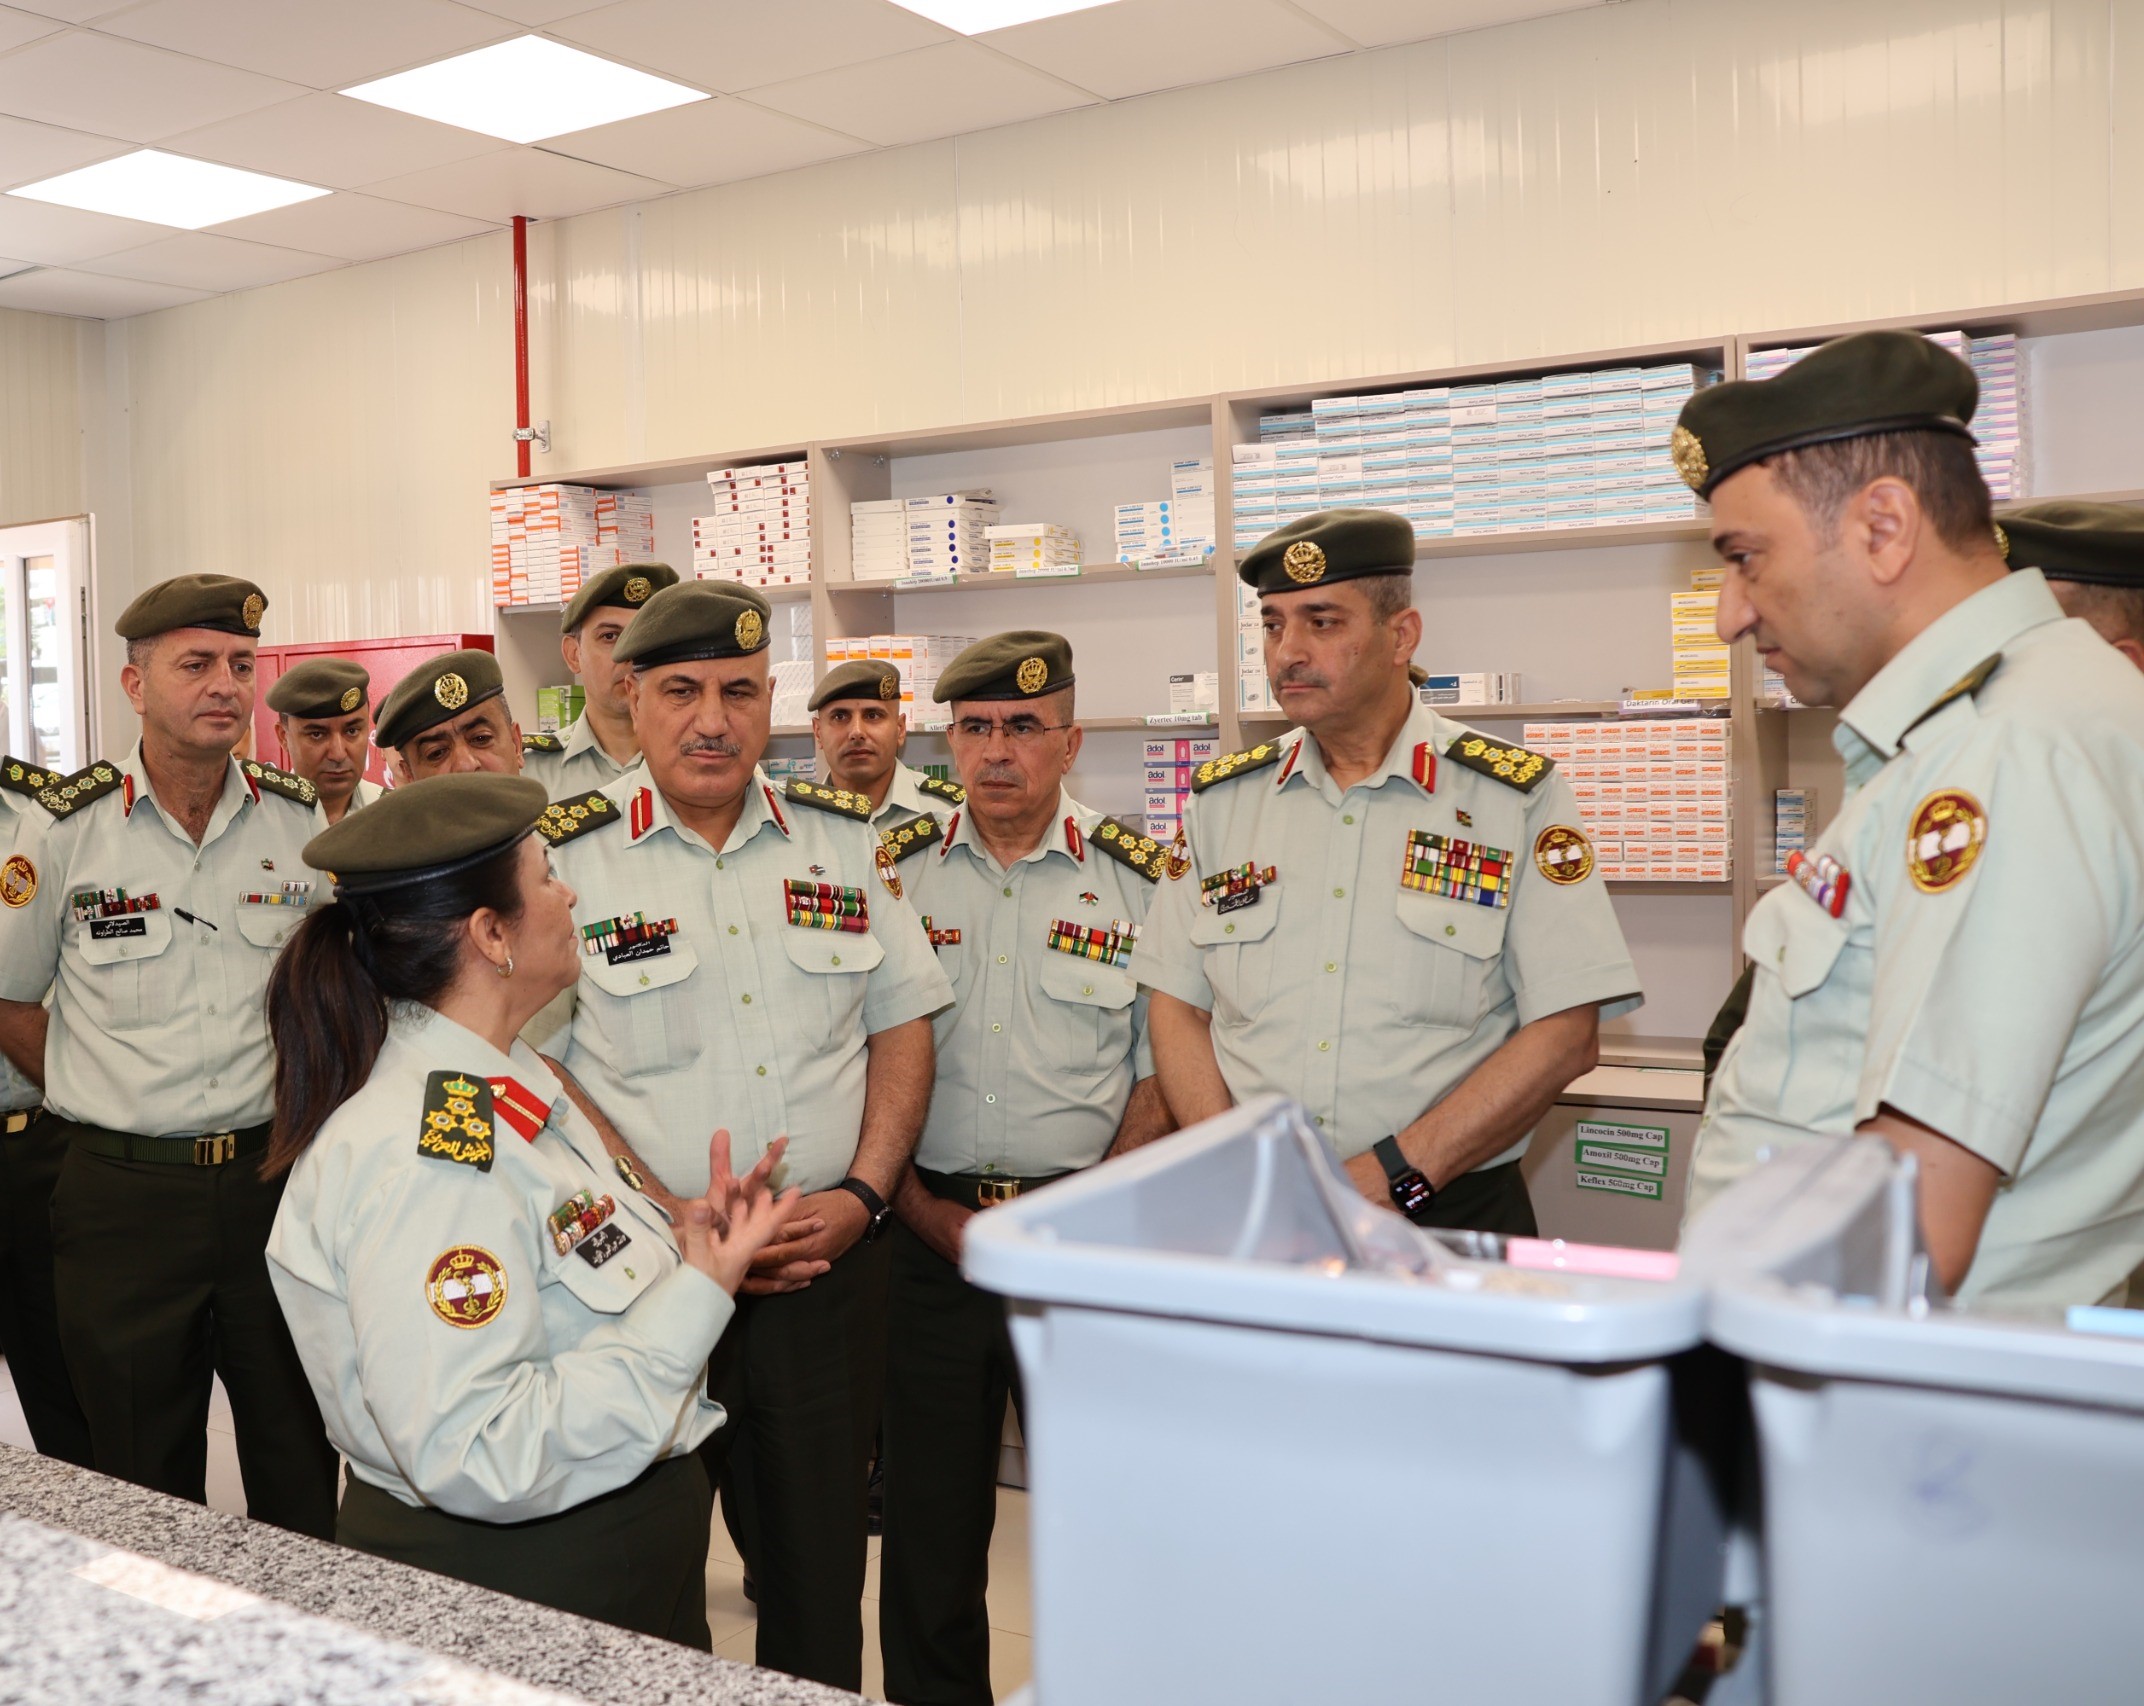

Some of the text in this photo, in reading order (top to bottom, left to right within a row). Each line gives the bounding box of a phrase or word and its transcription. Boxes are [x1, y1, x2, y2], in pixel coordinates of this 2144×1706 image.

[1580, 1126, 1663, 1141] Lincocin 500mg Cap
[1583, 1149, 1660, 1168] Amoxil 500mg Cap
[1580, 1176, 1654, 1192] Keflex 500mg Cap
